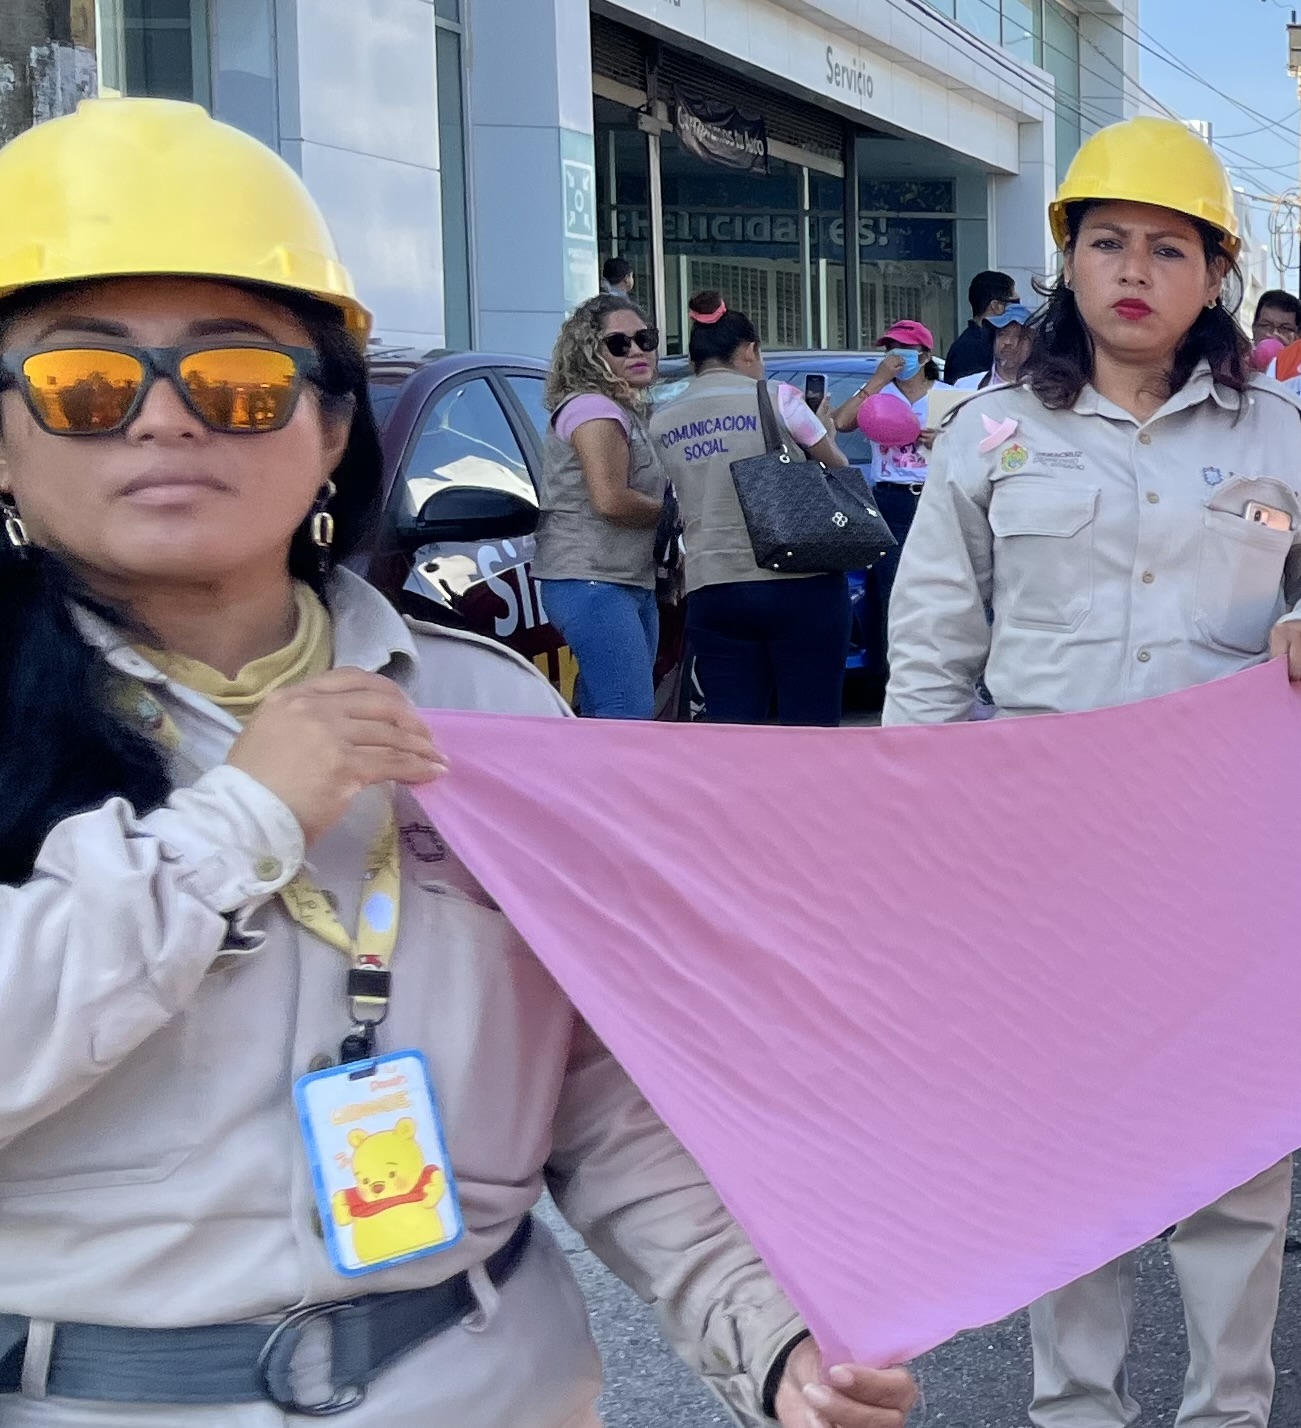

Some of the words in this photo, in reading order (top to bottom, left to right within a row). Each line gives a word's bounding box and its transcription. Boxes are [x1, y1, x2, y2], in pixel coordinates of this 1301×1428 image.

[826, 45, 874, 99] Servicio
[660, 415, 757, 449] COMUNICACION
[684, 437, 729, 463] SOCIAL
